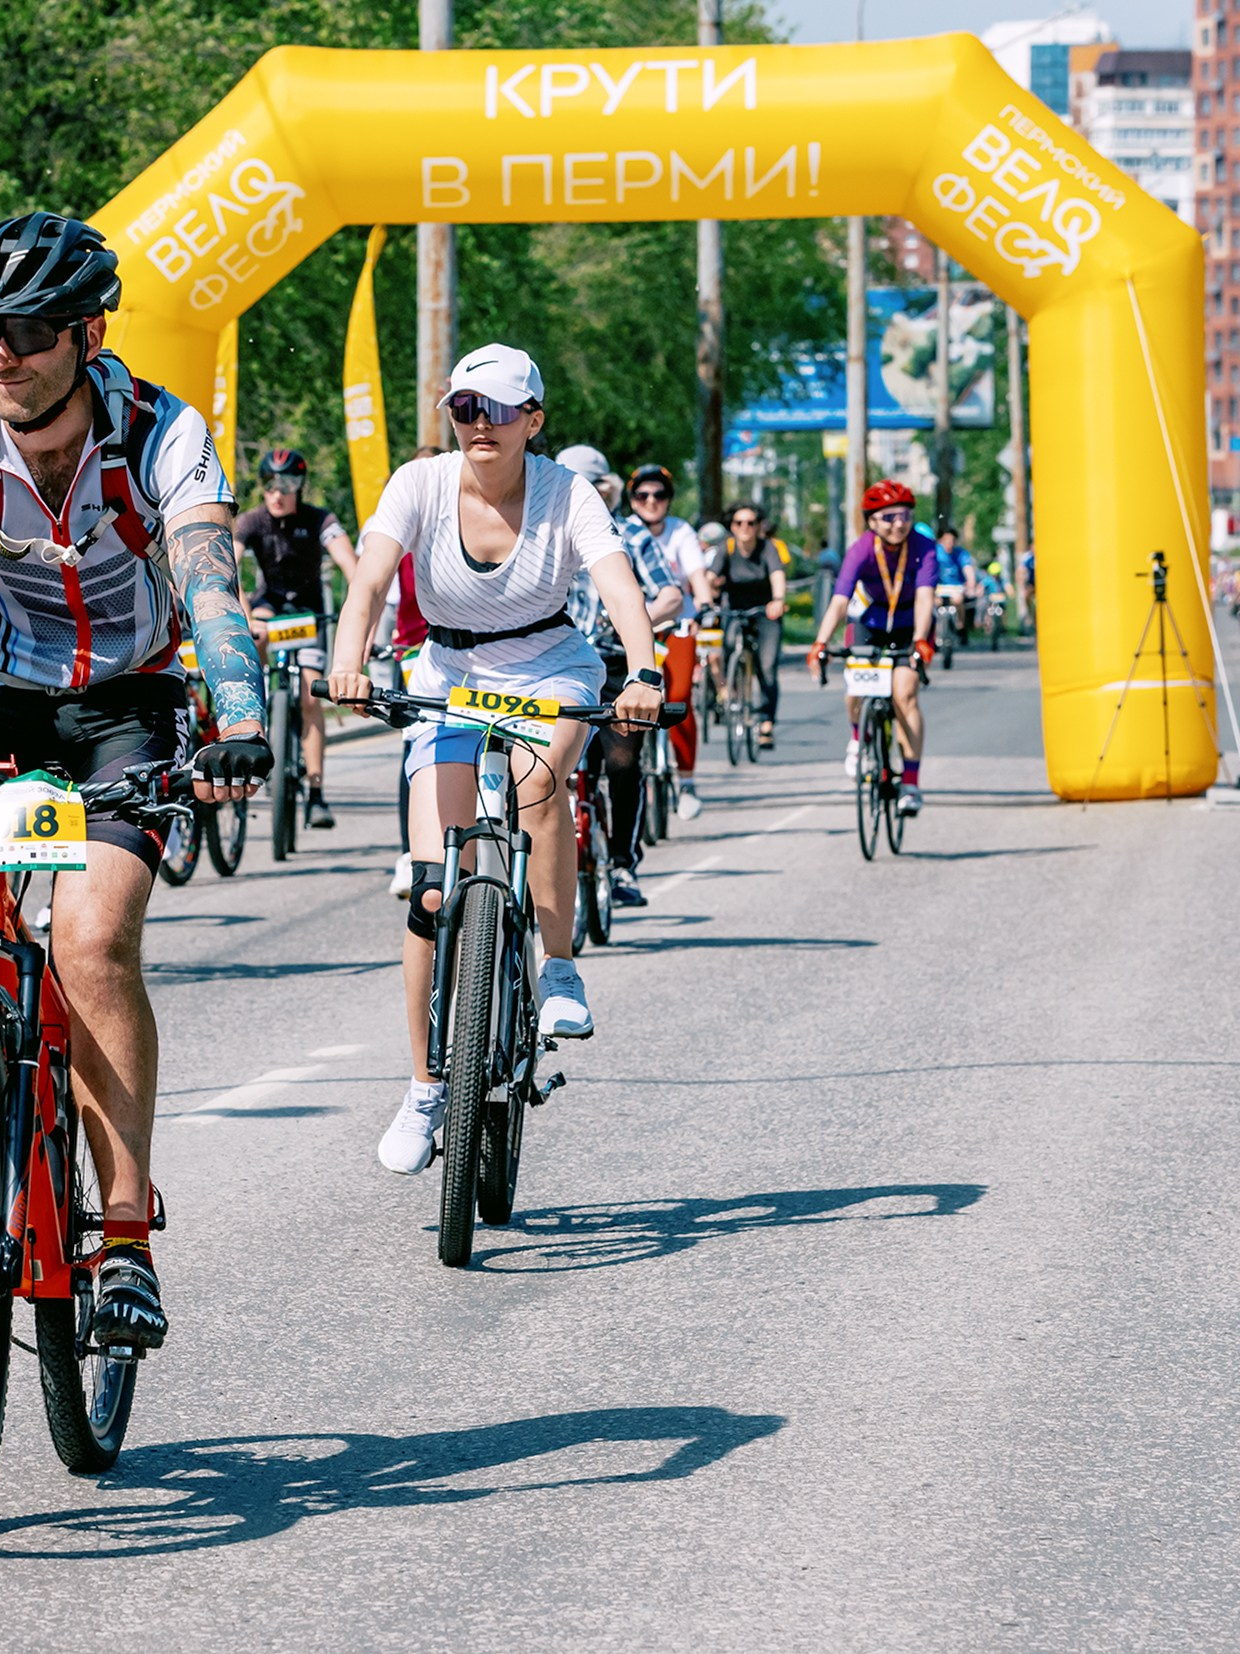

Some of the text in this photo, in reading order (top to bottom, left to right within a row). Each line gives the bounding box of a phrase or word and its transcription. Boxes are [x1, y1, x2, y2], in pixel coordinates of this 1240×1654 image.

[484, 57, 758, 119] КРУТИ
[422, 142, 822, 208] В ПЕРМИ!
[465, 689, 541, 717] 1096
